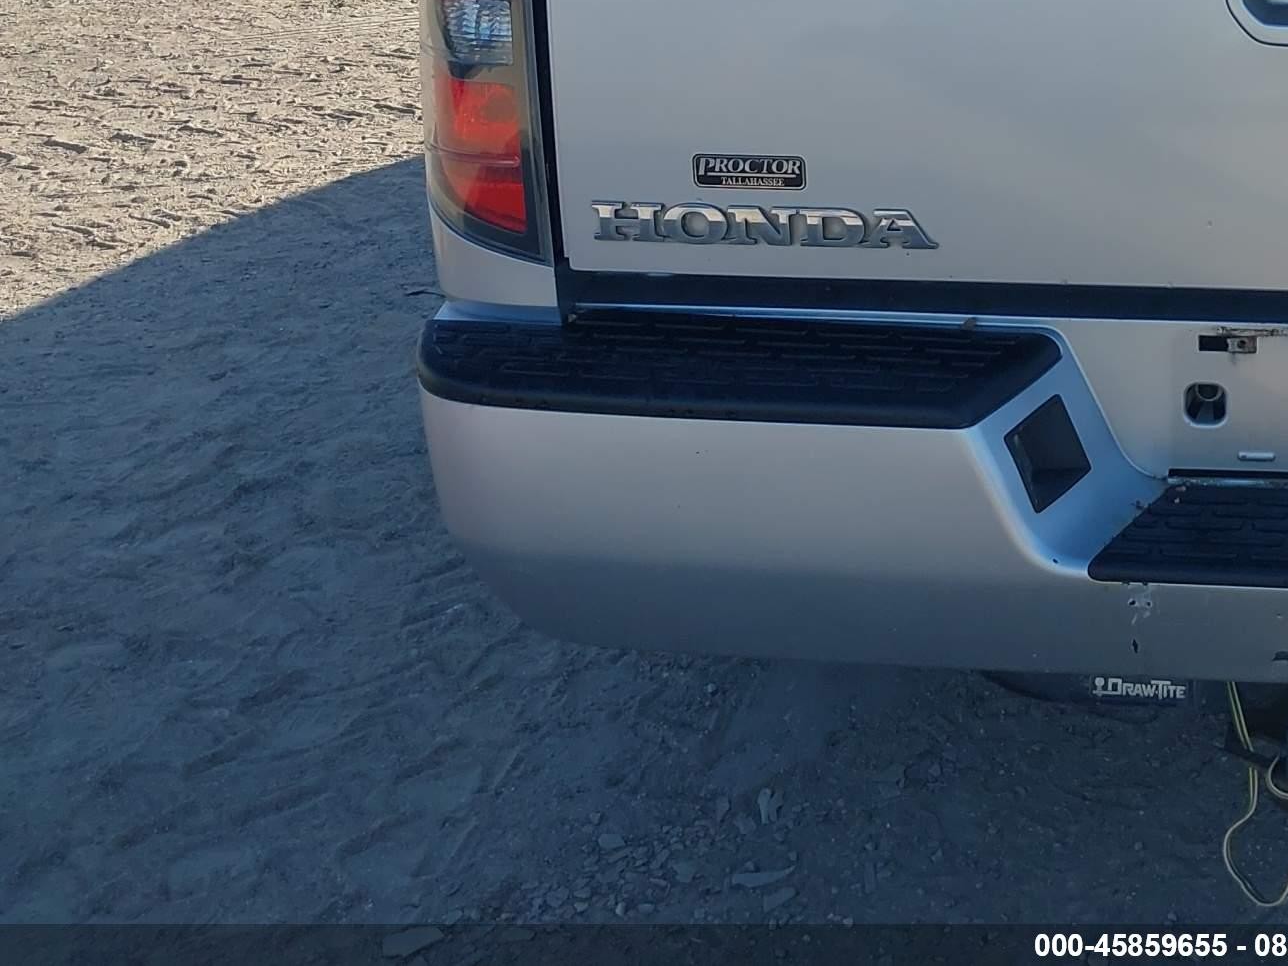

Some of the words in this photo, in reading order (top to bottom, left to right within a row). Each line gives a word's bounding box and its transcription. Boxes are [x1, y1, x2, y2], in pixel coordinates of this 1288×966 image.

[698, 157, 801, 176] PROCTOR
[721, 176, 785, 187] TALLAHASSEE
[591, 201, 940, 250] HONDA
